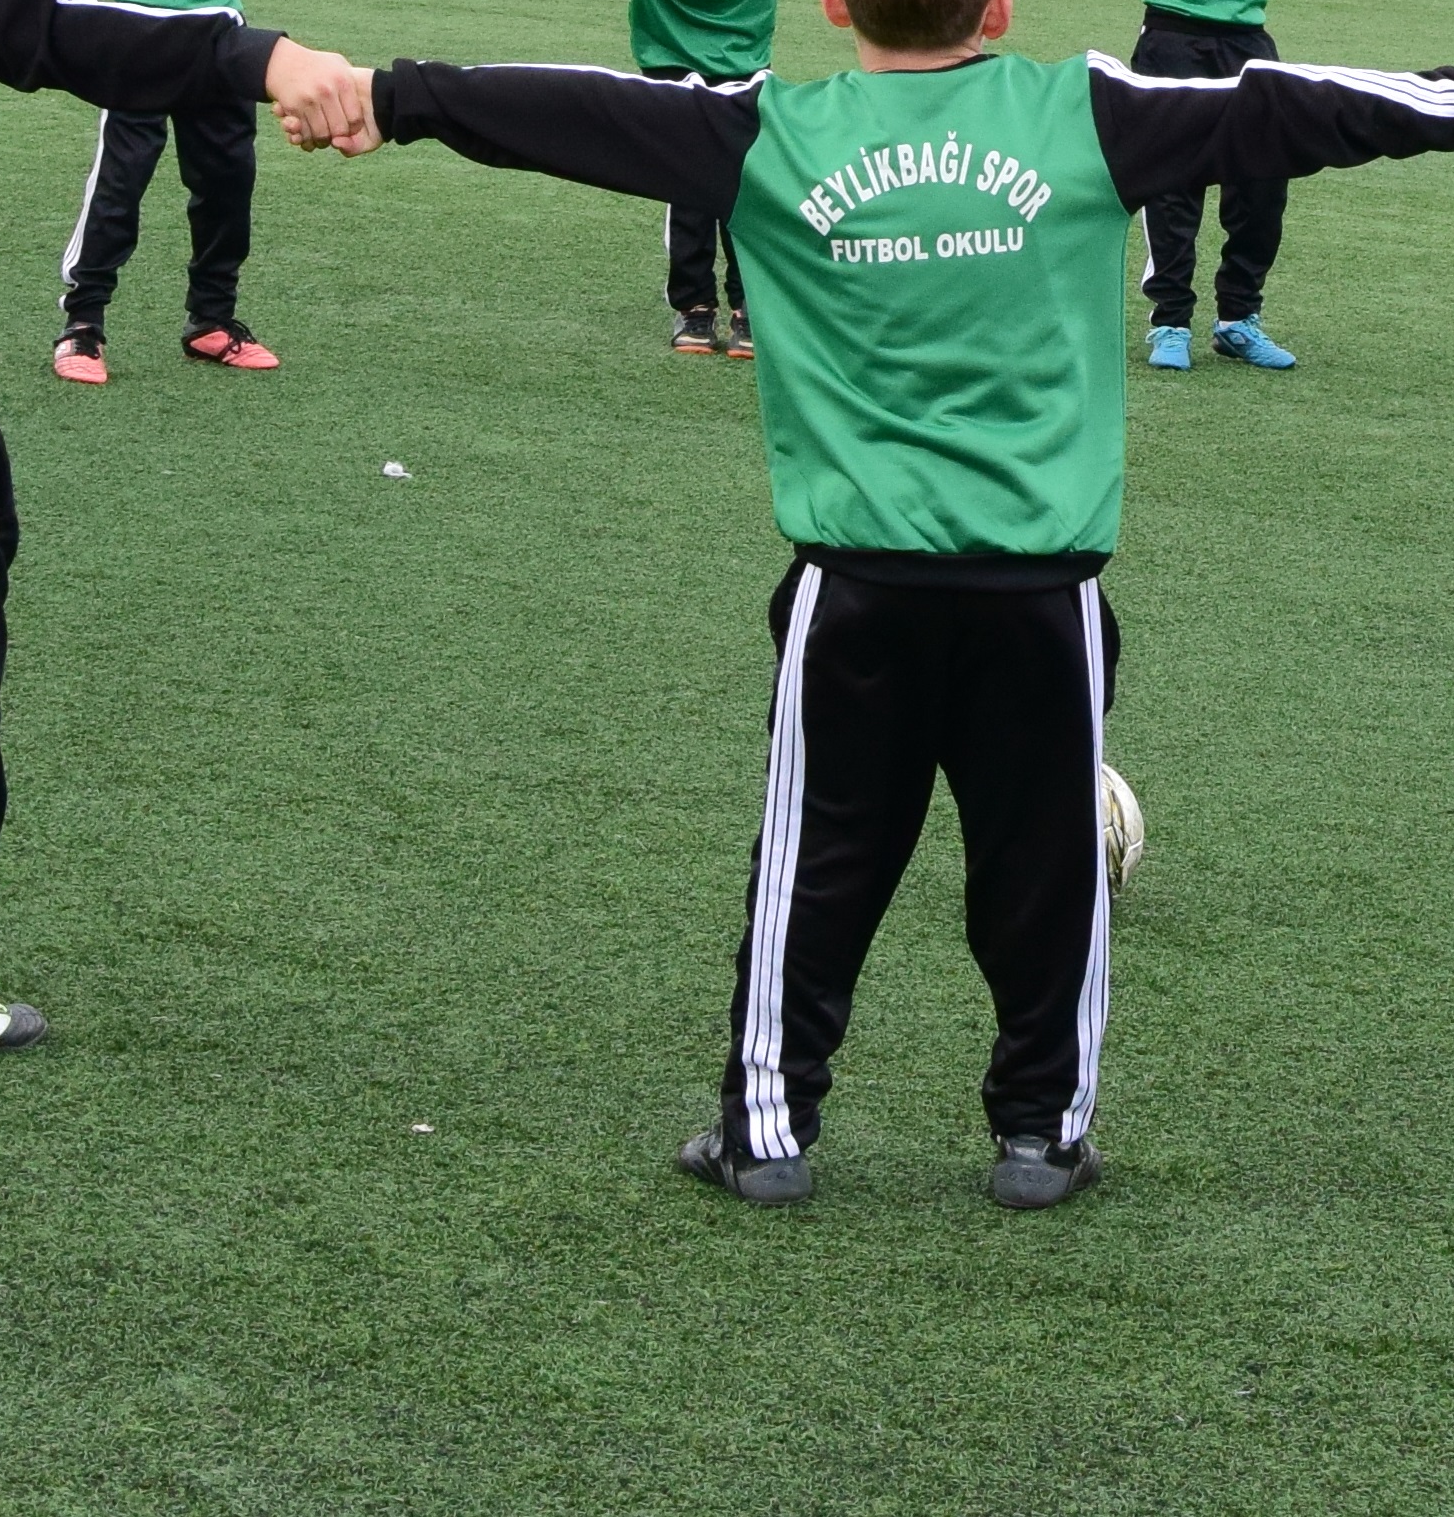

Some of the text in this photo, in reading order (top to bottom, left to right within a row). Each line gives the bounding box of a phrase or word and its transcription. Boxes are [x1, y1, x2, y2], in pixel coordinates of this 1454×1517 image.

[798, 131, 1052, 236] BEYLİKBAĞI SPOR
[831, 227, 1024, 263] FUTBOL OKULU
